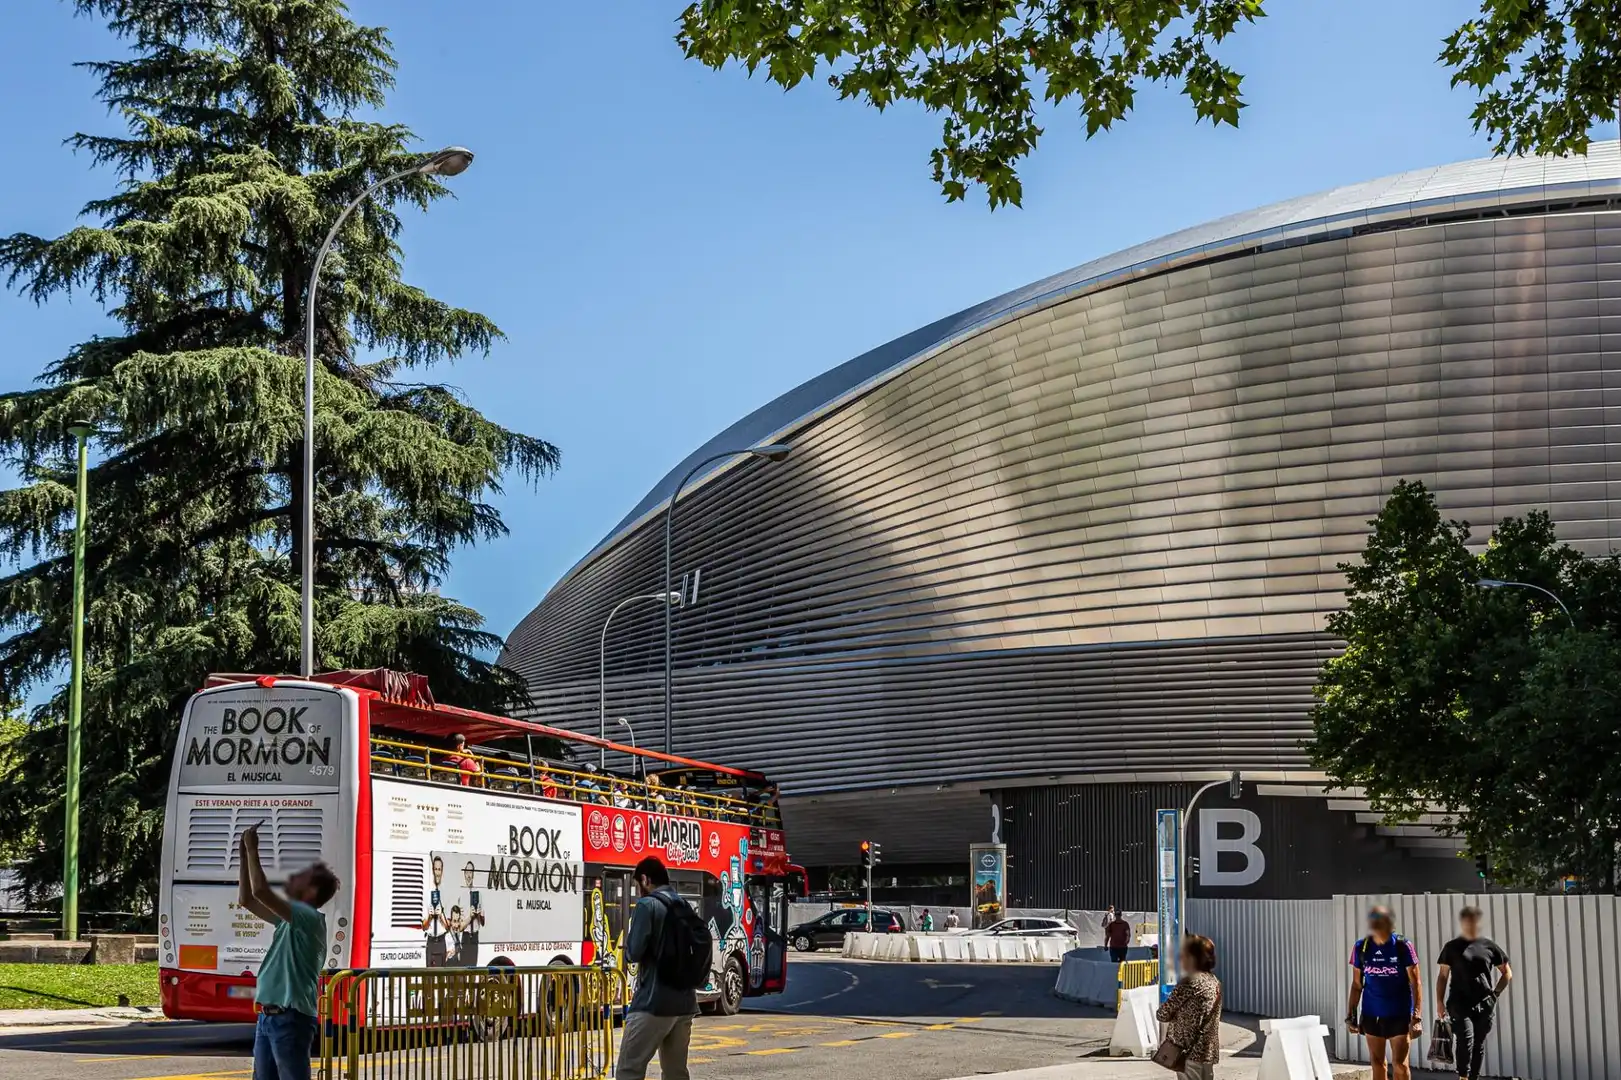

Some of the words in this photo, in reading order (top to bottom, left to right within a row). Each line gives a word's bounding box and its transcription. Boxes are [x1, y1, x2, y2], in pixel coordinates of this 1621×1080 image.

[204, 726, 217, 735] THE
[222, 707, 308, 735] BOOK
[309, 725, 322, 734] OF
[186, 736, 331, 766] MORMON
[227, 772, 236, 781] EL
[242, 772, 282, 781] MUSICAL
[309, 766, 334, 776] 4579
[281, 799, 313, 807] GRANDE
[497, 844, 507, 855] THE
[509, 824, 562, 859] BOOK
[563, 851, 571, 860] OF
[648, 815, 701, 850] MADRID
[1199, 809, 1266, 886] B
[487, 856, 578, 895] MORMON
[517, 899, 523, 909] EL
[526, 900, 552, 910] MUSICAL
[380, 952, 397, 961] TEATRO
[397, 950, 422, 960] CALDERÓN
[494, 944, 505, 952] ESTE
[506, 943, 528, 952] VERANO
[541, 943, 545, 951] A
[545, 942, 553, 951] LO
[553, 942, 573, 951] GRANDE
